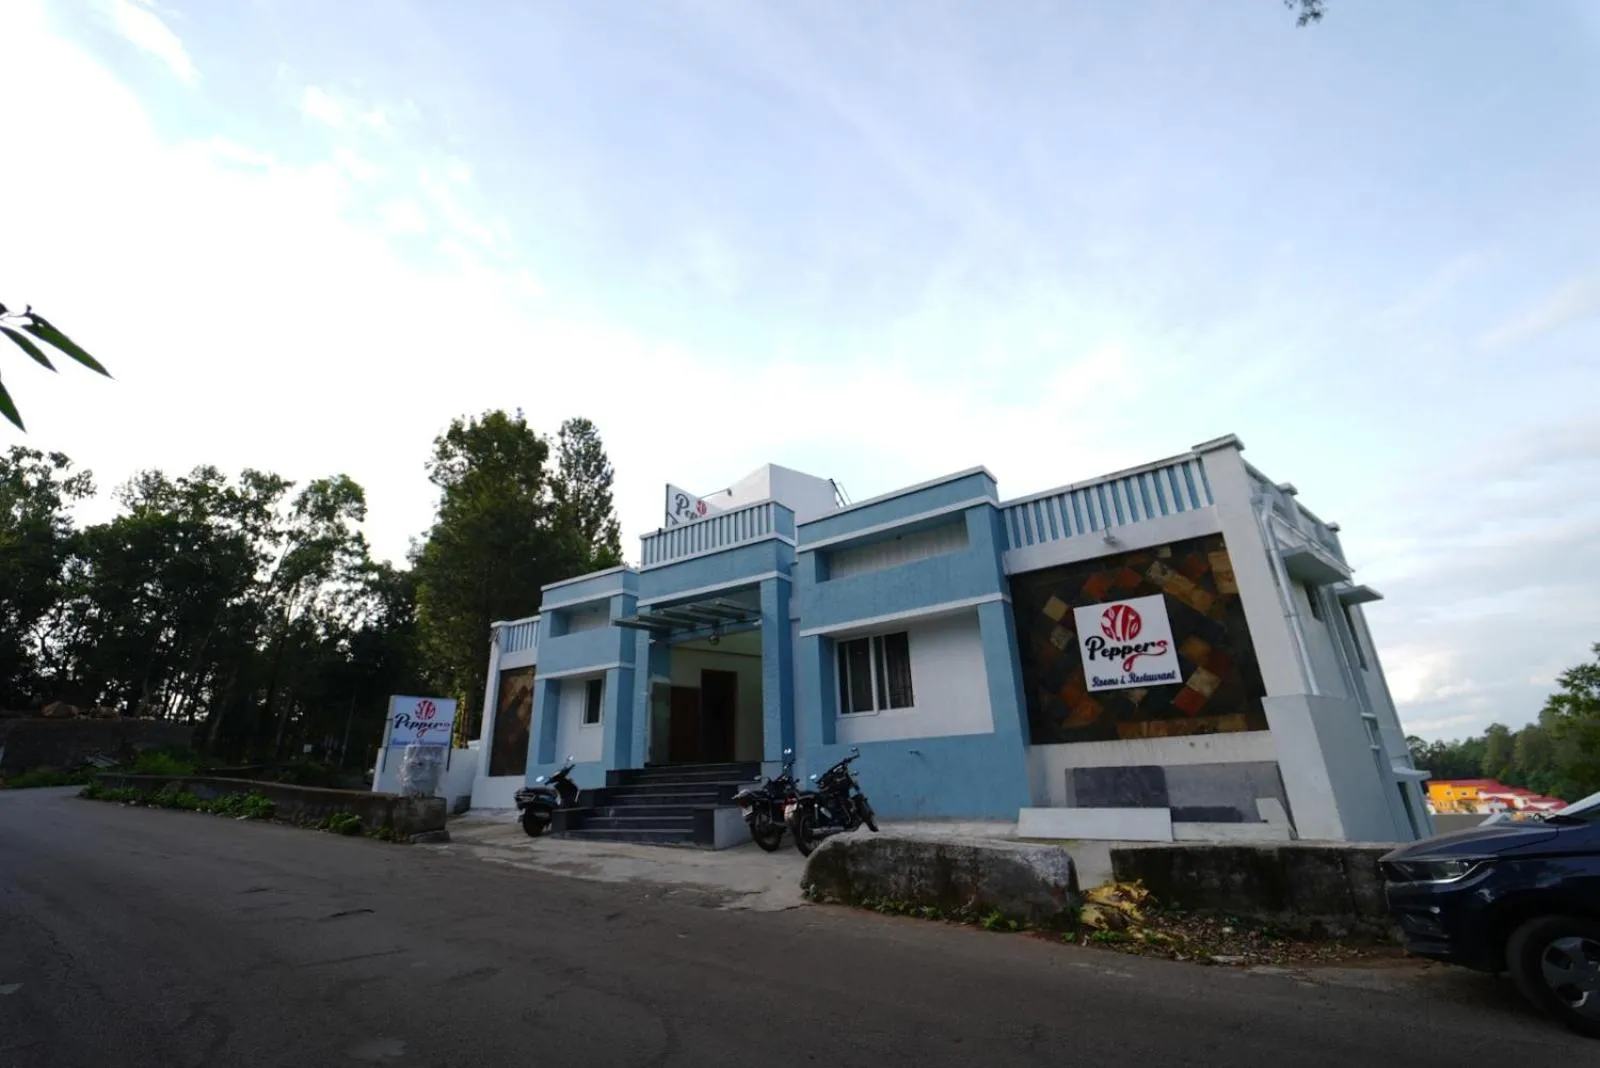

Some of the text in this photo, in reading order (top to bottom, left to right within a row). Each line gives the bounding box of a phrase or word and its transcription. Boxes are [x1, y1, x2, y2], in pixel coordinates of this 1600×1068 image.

[675, 493, 703, 520] Pep
[1085, 636, 1168, 672] Peppers
[1128, 670, 1176, 684] Restaurant
